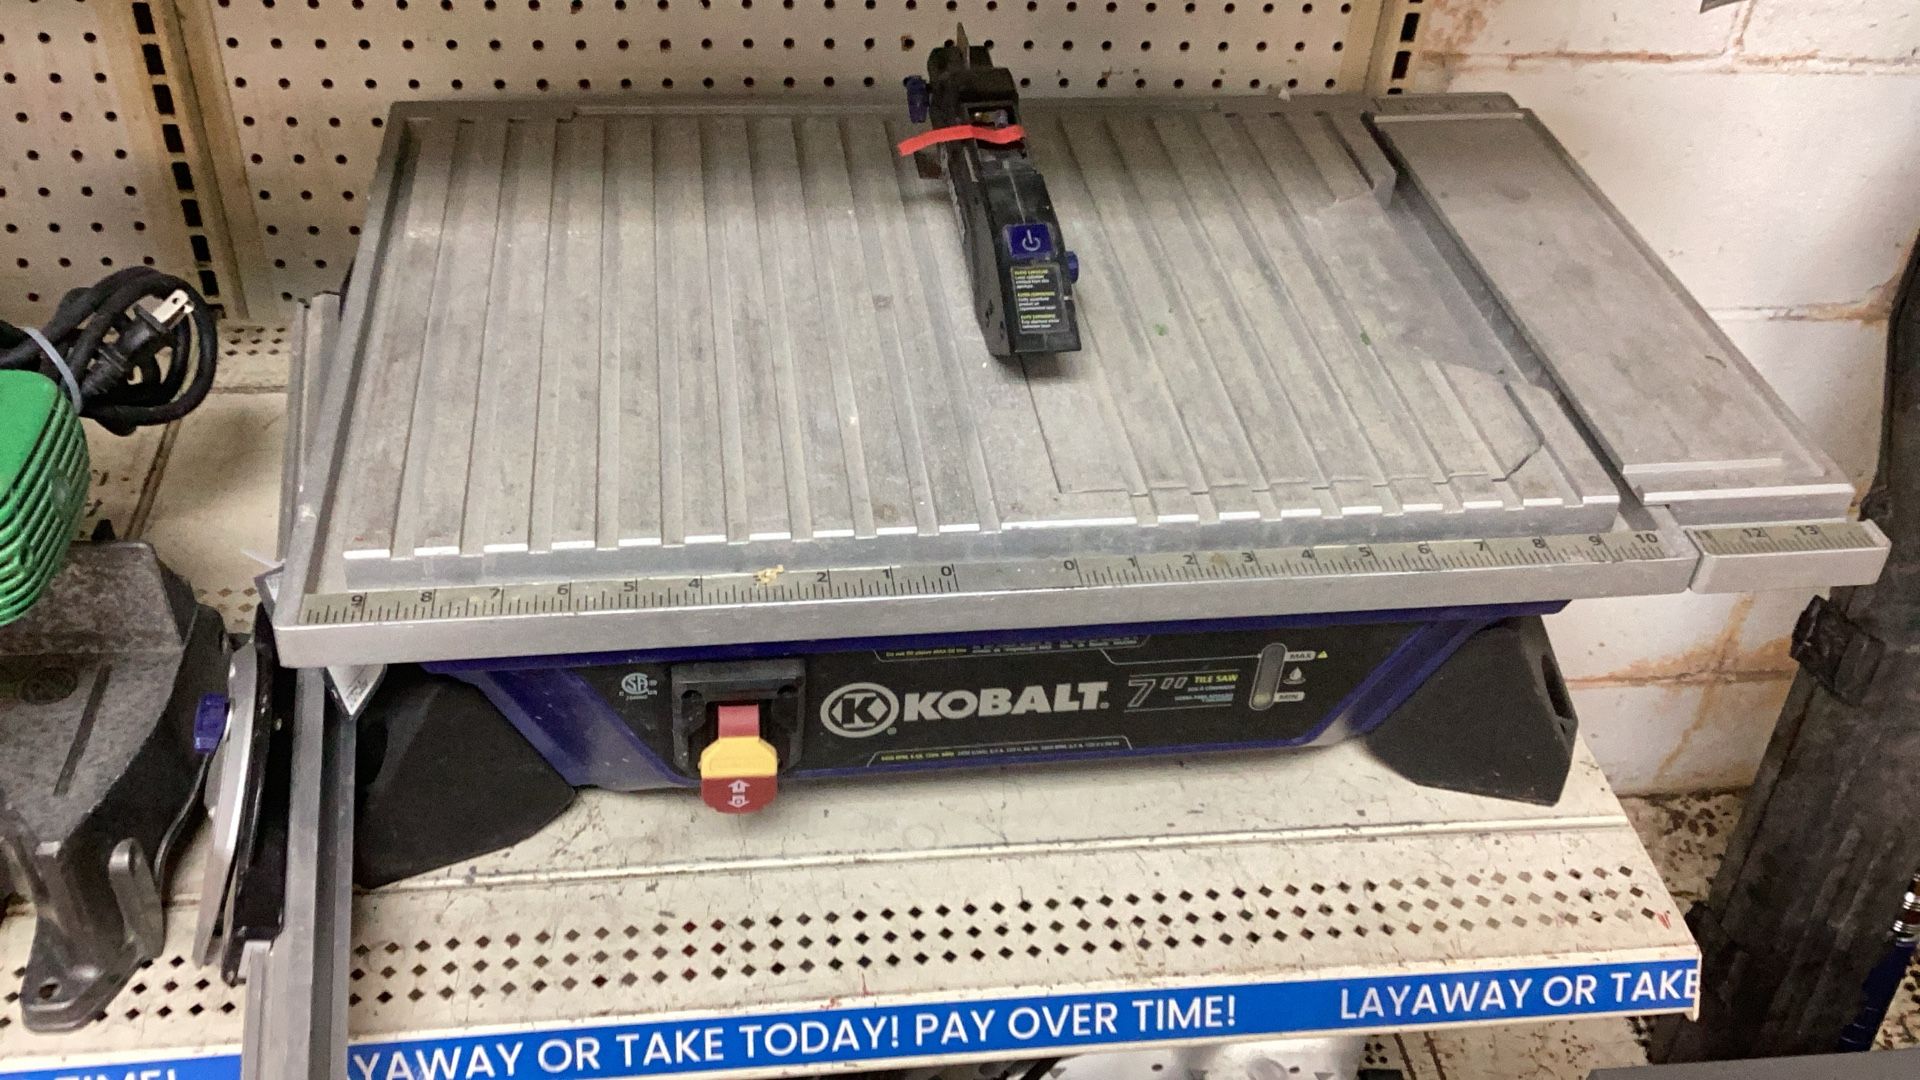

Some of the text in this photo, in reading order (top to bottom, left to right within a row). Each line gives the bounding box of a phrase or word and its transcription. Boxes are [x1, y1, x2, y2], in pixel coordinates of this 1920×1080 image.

[1063, 560, 1075, 571] 0
[1183, 554, 1196, 565] 2
[1242, 552, 1254, 563] 3
[1301, 549, 1314, 560] 4
[1359, 547, 1371, 558] 5
[1418, 543, 1430, 554] 6
[1474, 541, 1484, 552] 7
[1532, 538, 1546, 549] 8
[1588, 535, 1601, 547] 9
[1635, 533, 1658, 544] 10
[1743, 527, 1766, 538] 12
[1796, 525, 1818, 536] 13
[351, 565, 953, 608] 9 8 7 6 5 4 2 1 0
[904, 682, 1108, 722] KOBALT
[1341, 969, 1698, 1020] LAYAWAY OR TAKE
[347, 994, 1236, 1080] YAWAY OR TAKE TODAY! PAY OVER TIME!
